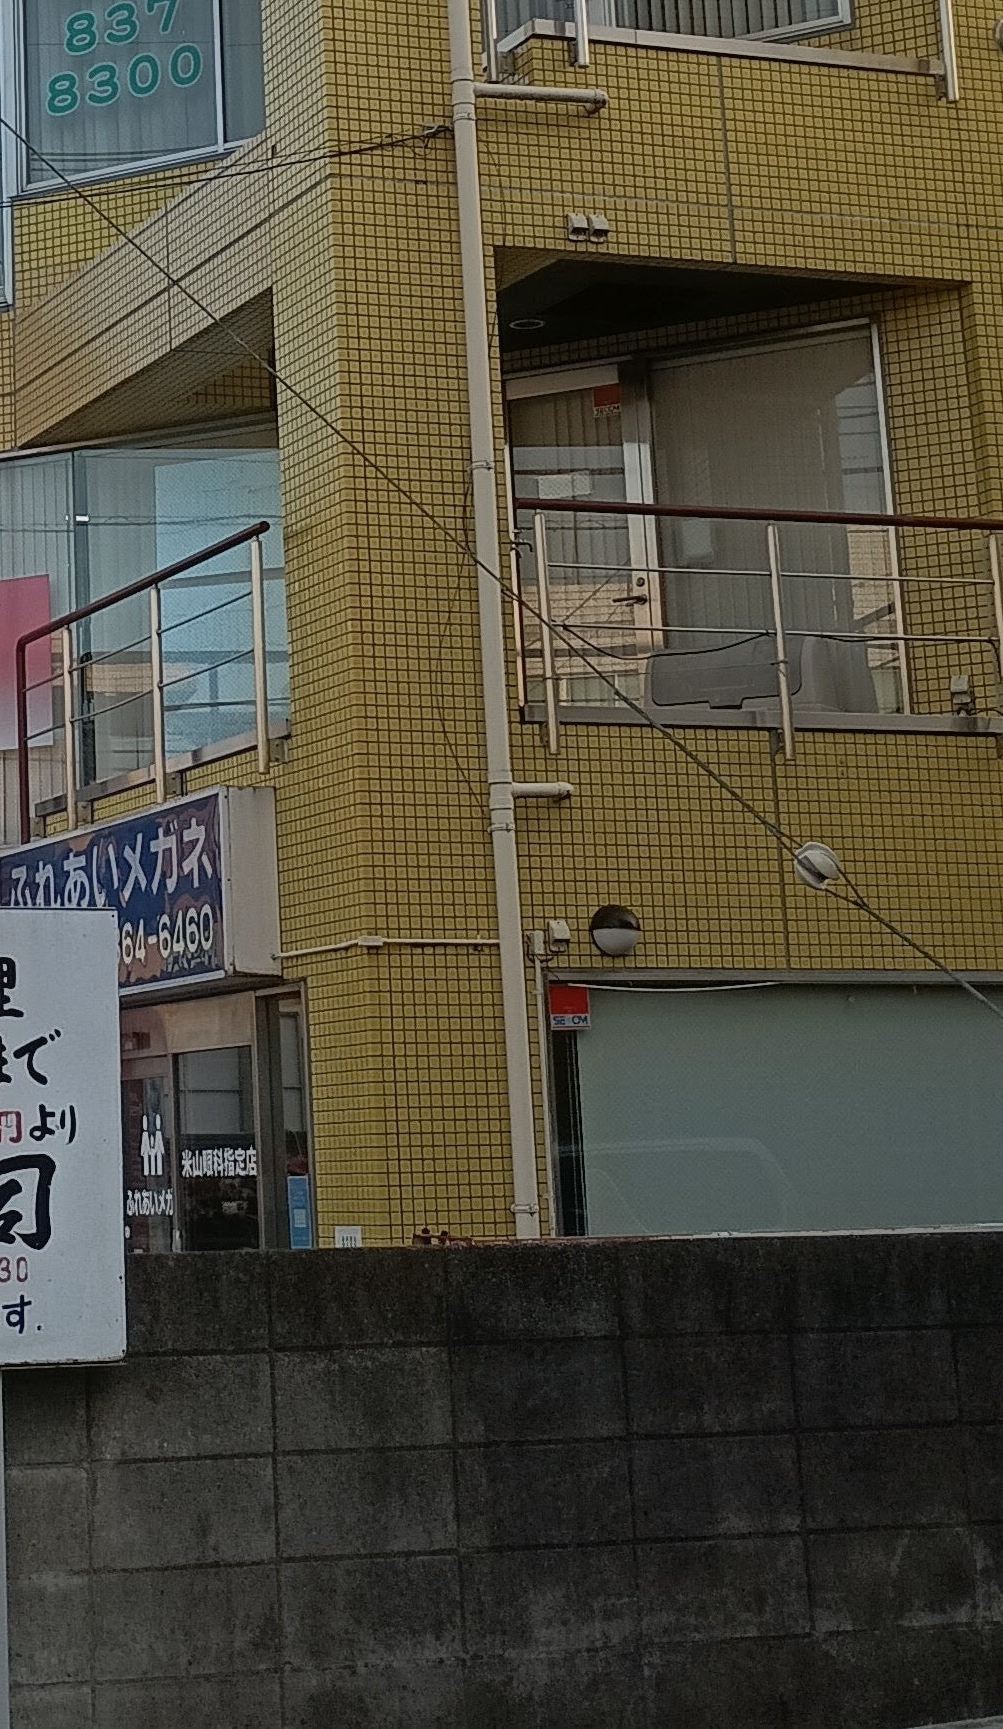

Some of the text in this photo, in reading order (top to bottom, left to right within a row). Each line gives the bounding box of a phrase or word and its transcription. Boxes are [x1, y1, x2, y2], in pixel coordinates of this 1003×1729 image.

[45, 44, 204, 116] 8300
[9, 817, 213, 908] ふれあいメガネ
[117, 903, 214, 967] 64-6460
